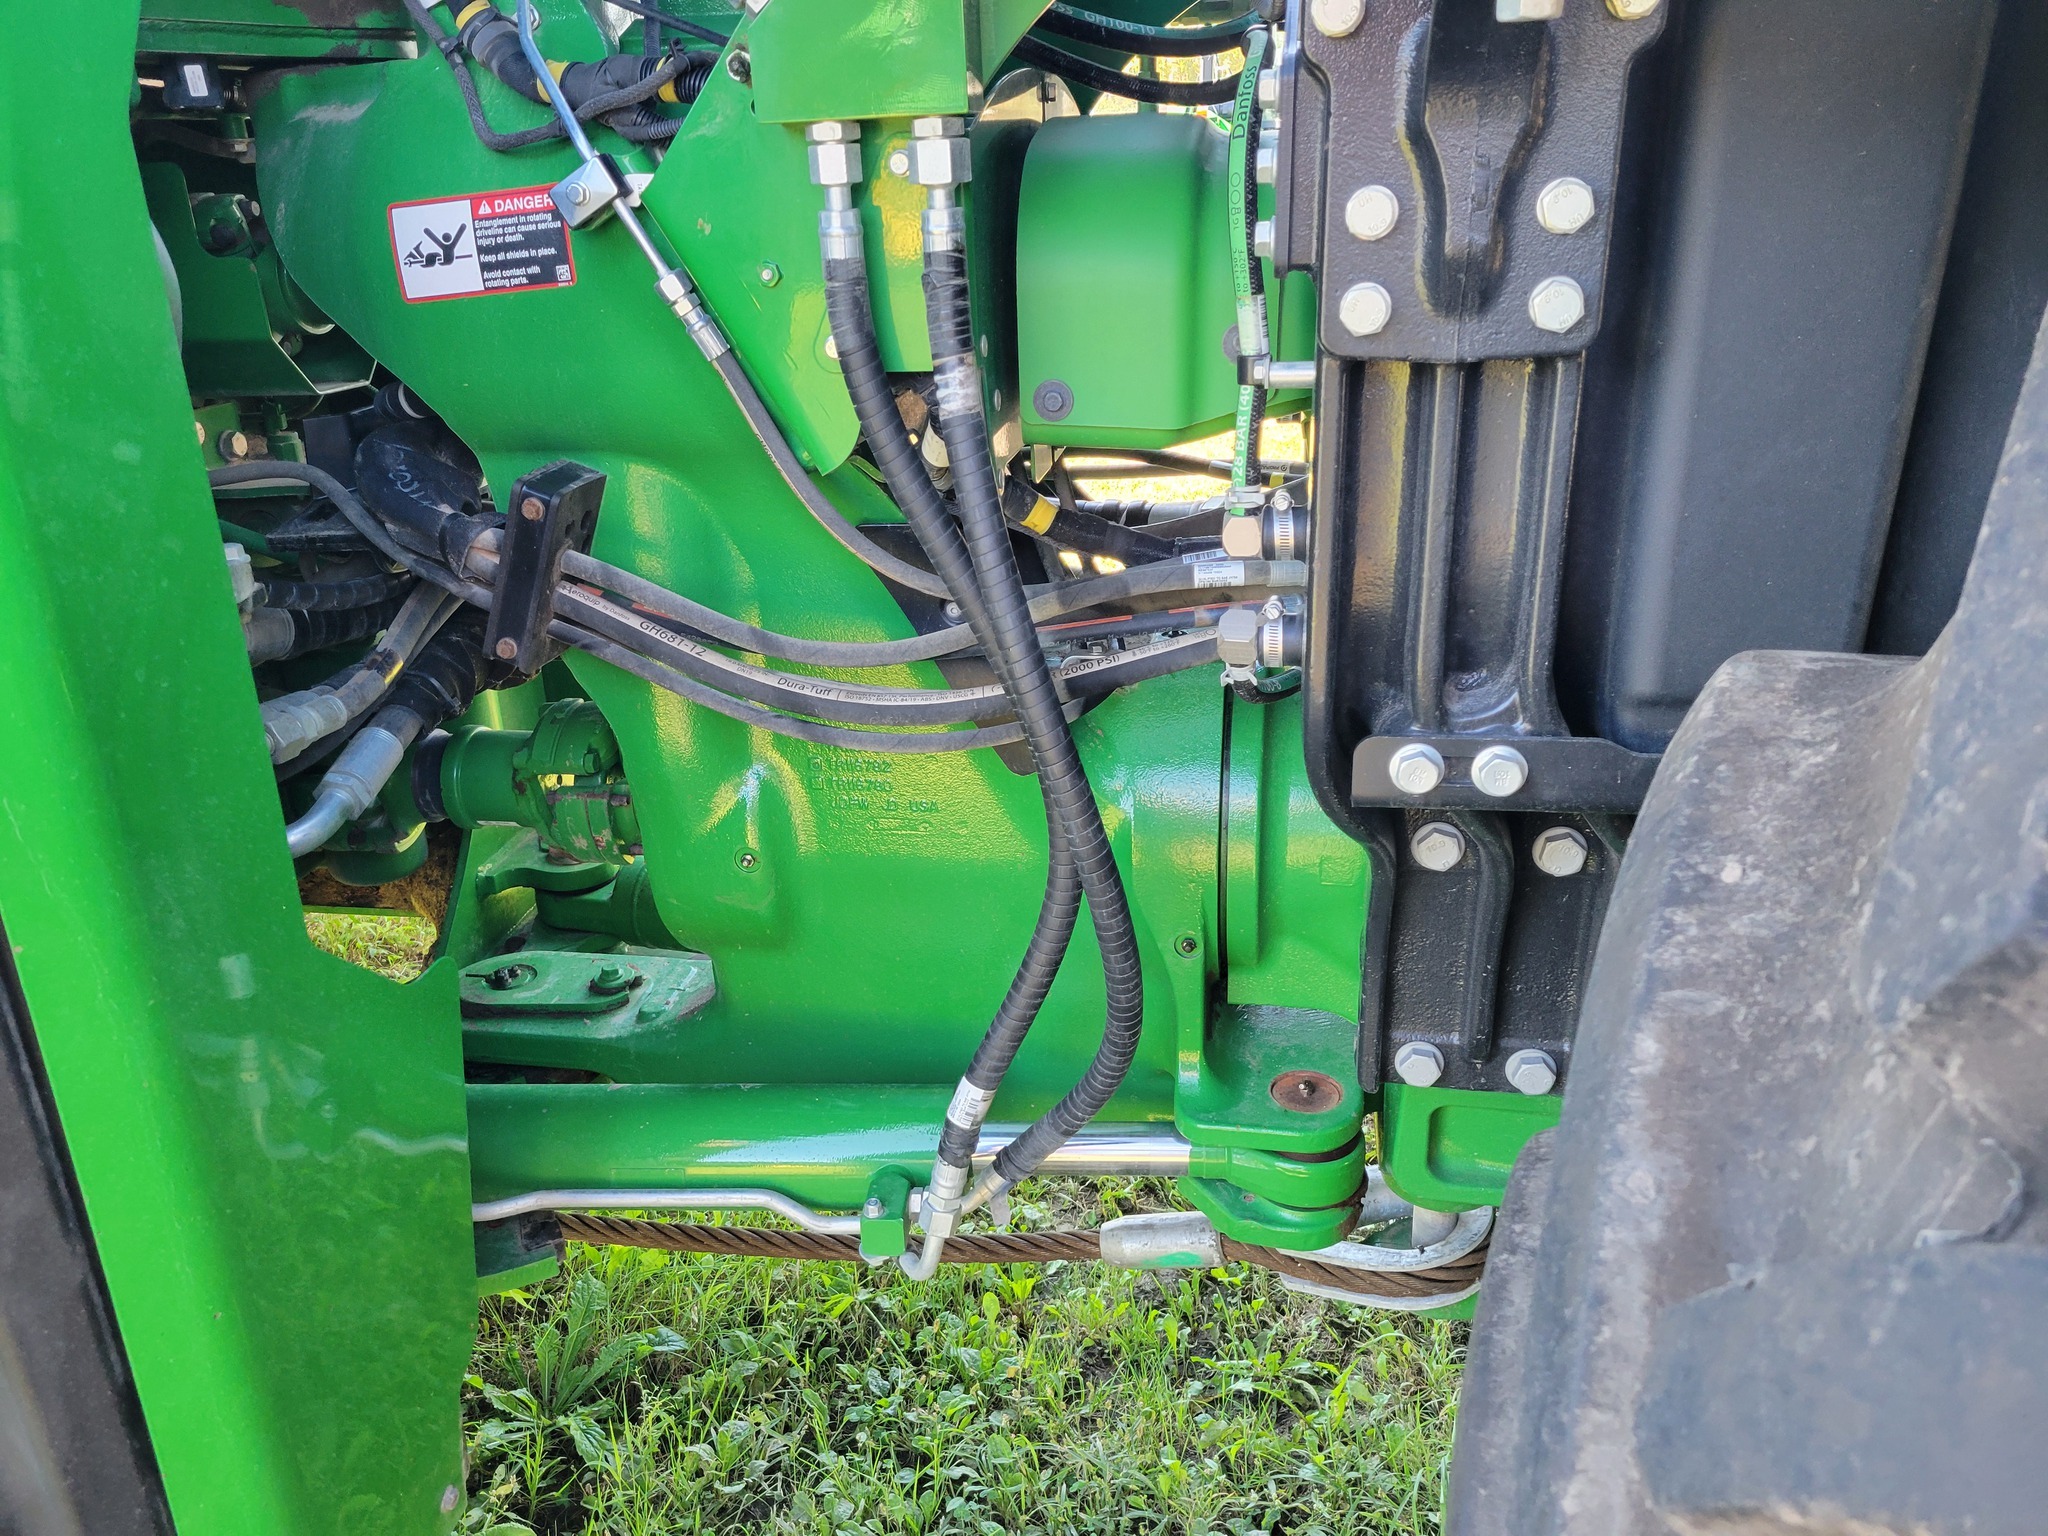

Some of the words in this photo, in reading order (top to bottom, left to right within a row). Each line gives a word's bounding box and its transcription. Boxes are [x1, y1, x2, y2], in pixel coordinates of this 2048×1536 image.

[1084, 10, 1156, 36] GH100-10
[1232, 65, 1257, 140] Danfoss
[494, 194, 554, 213] DANGER
[474, 216, 518, 228] Entanglement
[527, 212, 552, 222] rotating
[475, 228, 503, 237] driveline
[504, 226, 516, 234] can
[517, 224, 537, 233] cause
[537, 220, 561, 230] serious
[476, 236, 496, 247] injury
[504, 233, 525, 242] death.
[480, 254, 496, 263] Keep
[497, 252, 506, 260] all
[506, 249, 530, 259] shields
[530, 248, 537, 257] in
[537, 247, 558, 257] place.
[483, 269, 501, 279] Avoid
[502, 267, 526, 277] contact
[526, 265, 541, 274] with
[484, 278, 510, 288] rotating
[510, 276, 529, 287] parts.
[1236, 415, 1248, 451] BAR
[639, 620, 707, 657] GH681-12
[1060, 661, 1094, 677] (2000
[1097, 655, 1120, 667] PSI)
[777, 677, 832, 696] Dura-Tuff
